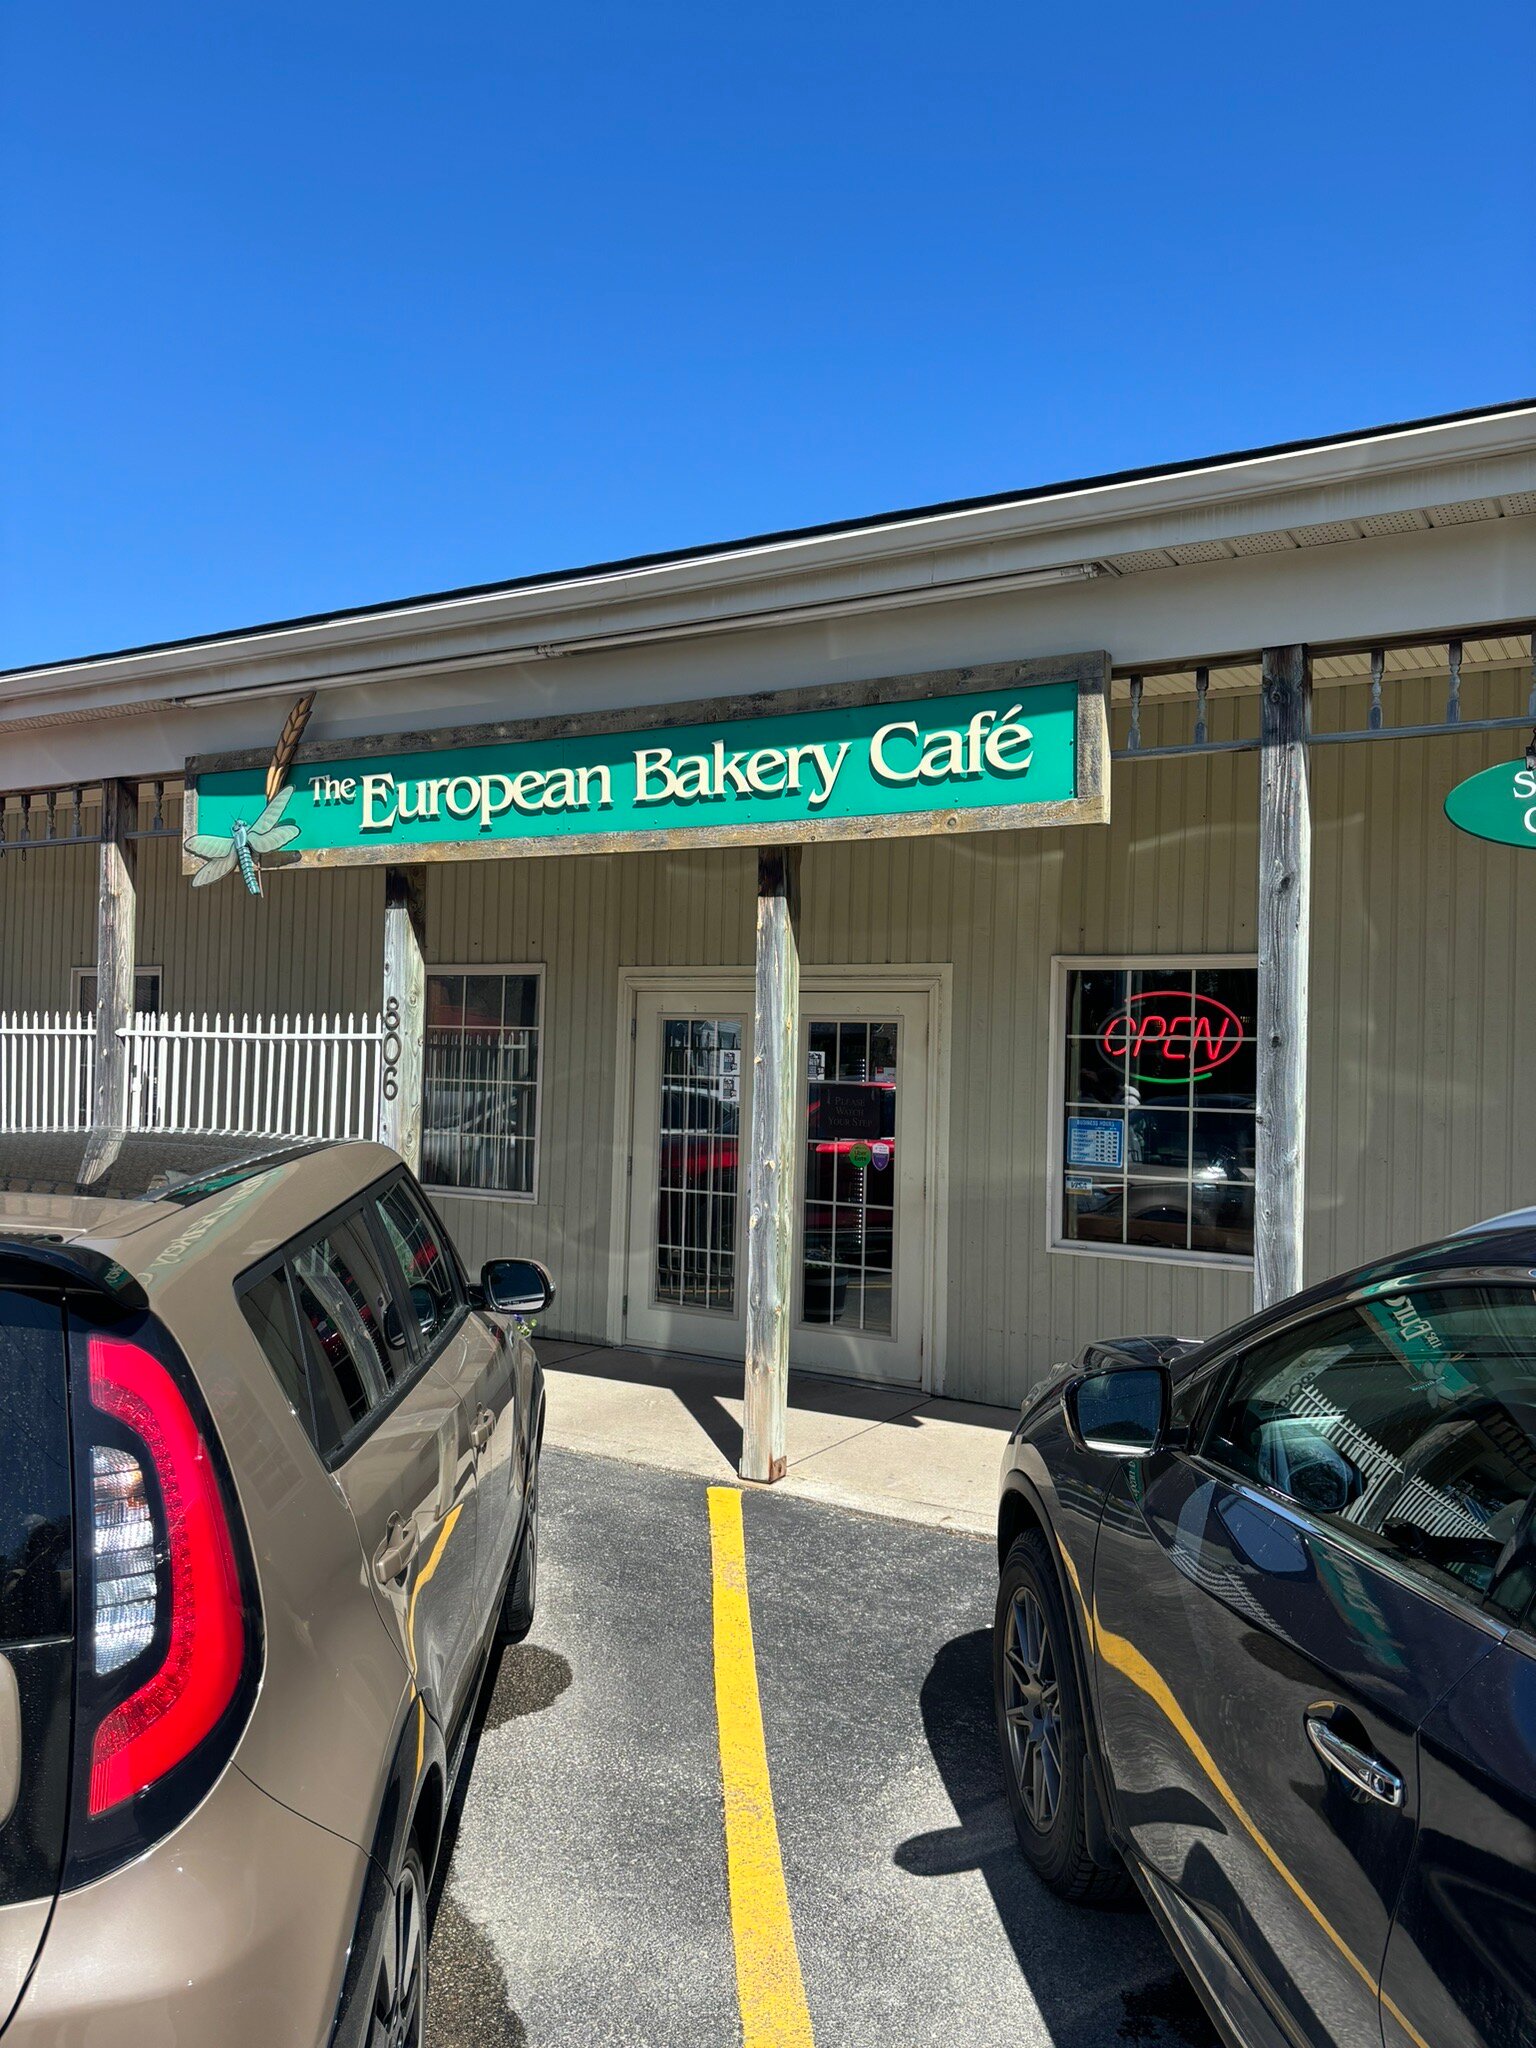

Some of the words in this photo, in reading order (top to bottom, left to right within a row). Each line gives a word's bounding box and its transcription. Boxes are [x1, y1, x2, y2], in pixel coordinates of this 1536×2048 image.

[308, 774, 357, 803] The
[359, 764, 614, 829] European
[632, 739, 852, 804] Bakery
[869, 703, 1034, 781] Café
[382, 995, 402, 1101] 806
[1104, 1015, 1230, 1060] OPEN
